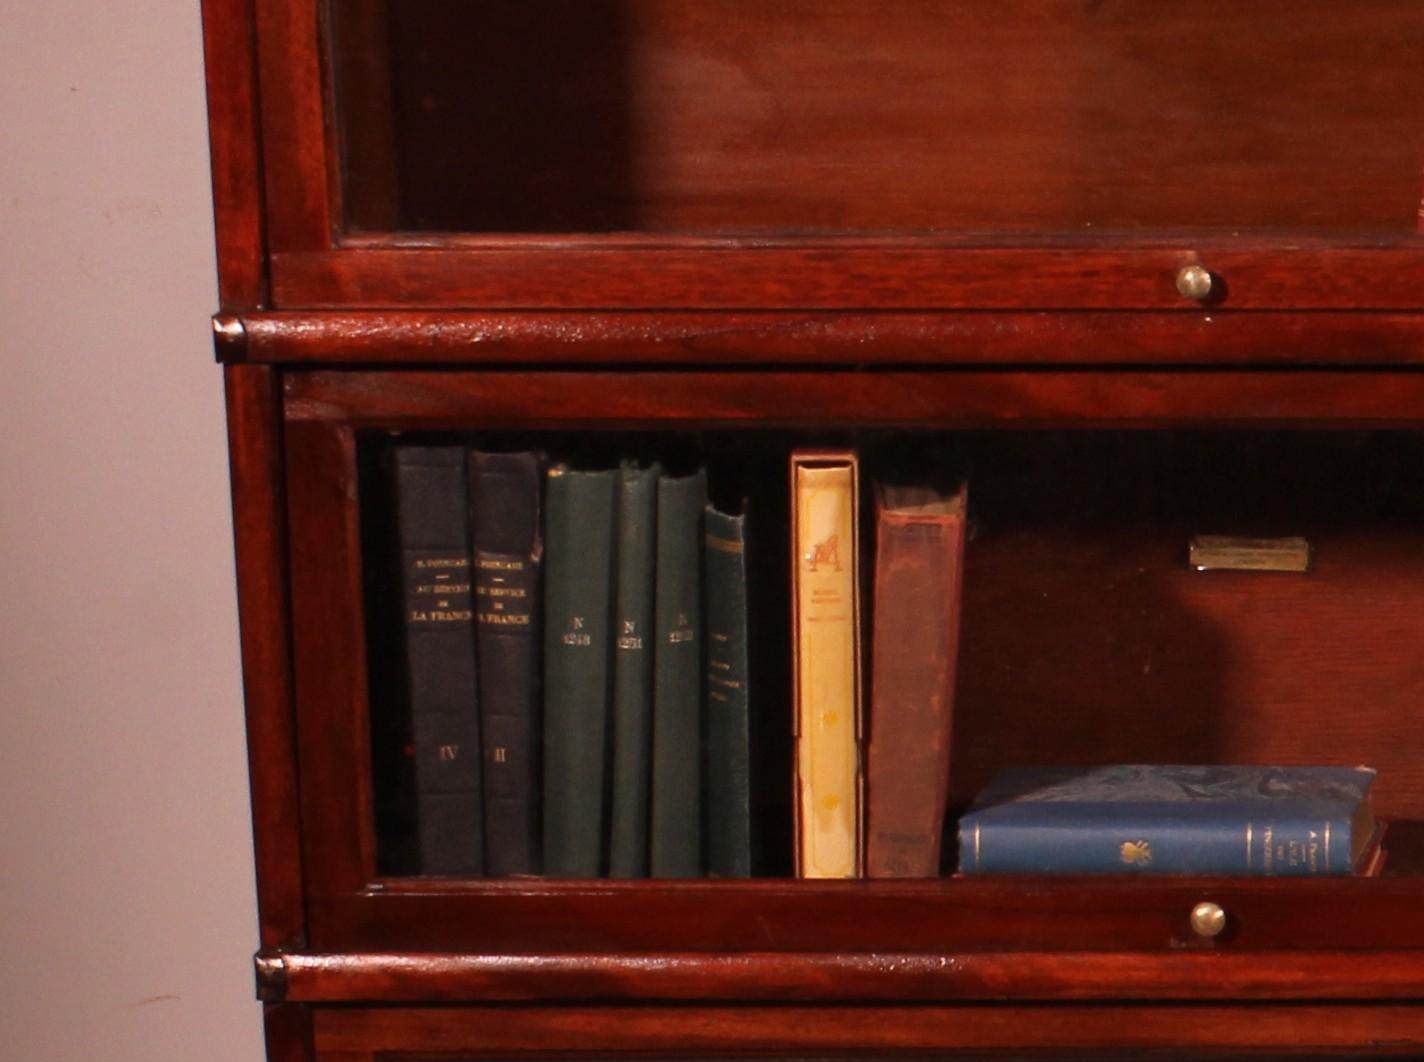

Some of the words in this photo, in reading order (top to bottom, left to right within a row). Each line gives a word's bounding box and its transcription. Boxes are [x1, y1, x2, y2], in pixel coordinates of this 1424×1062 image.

[411, 611, 427, 621] LA
[440, 745, 459, 761] IV
[494, 746, 506, 763] II
